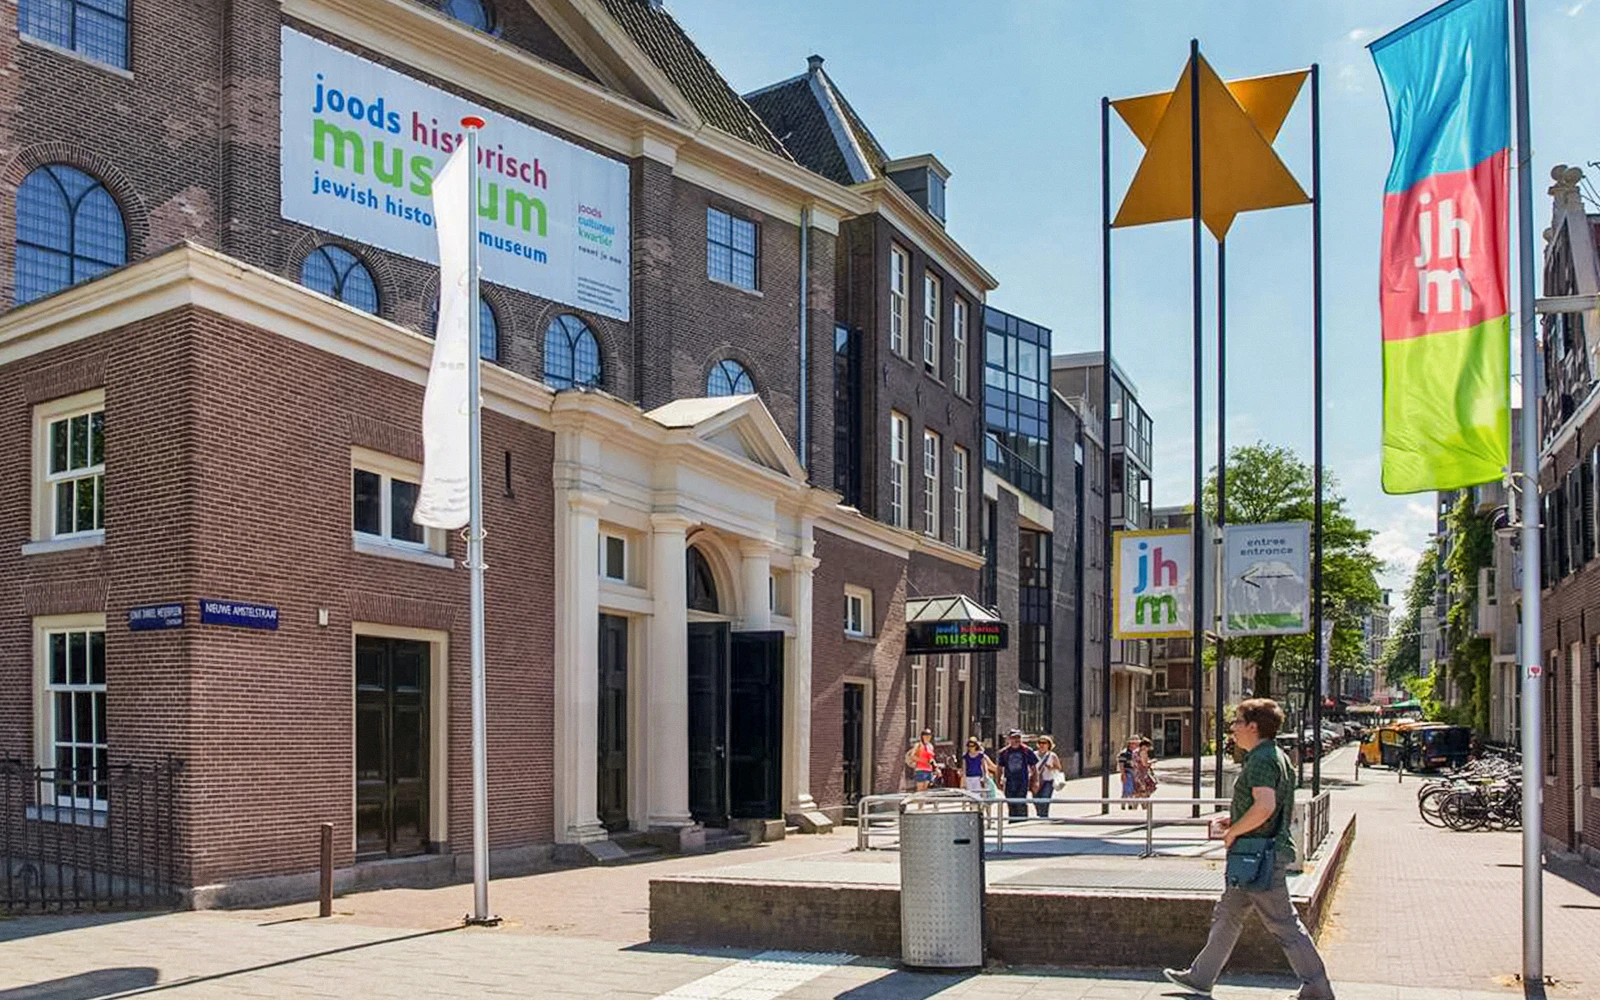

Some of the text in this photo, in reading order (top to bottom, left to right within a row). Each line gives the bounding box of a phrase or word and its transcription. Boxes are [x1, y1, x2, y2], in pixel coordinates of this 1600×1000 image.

[312, 73, 401, 134] joods
[313, 118, 547, 237] musum
[312, 171, 378, 209] jewish
[478, 231, 547, 264] museum
[1414, 192, 1471, 268] jh
[1418, 268, 1472, 313] m
[1240, 547, 1294, 556] entrance
[1247, 538, 1286, 547] entree
[1132, 541, 1178, 594] jh
[232, 606, 277, 619] AMSTELSTRAAT
[1135, 594, 1178, 625] m
[935, 634, 1000, 645] museum
